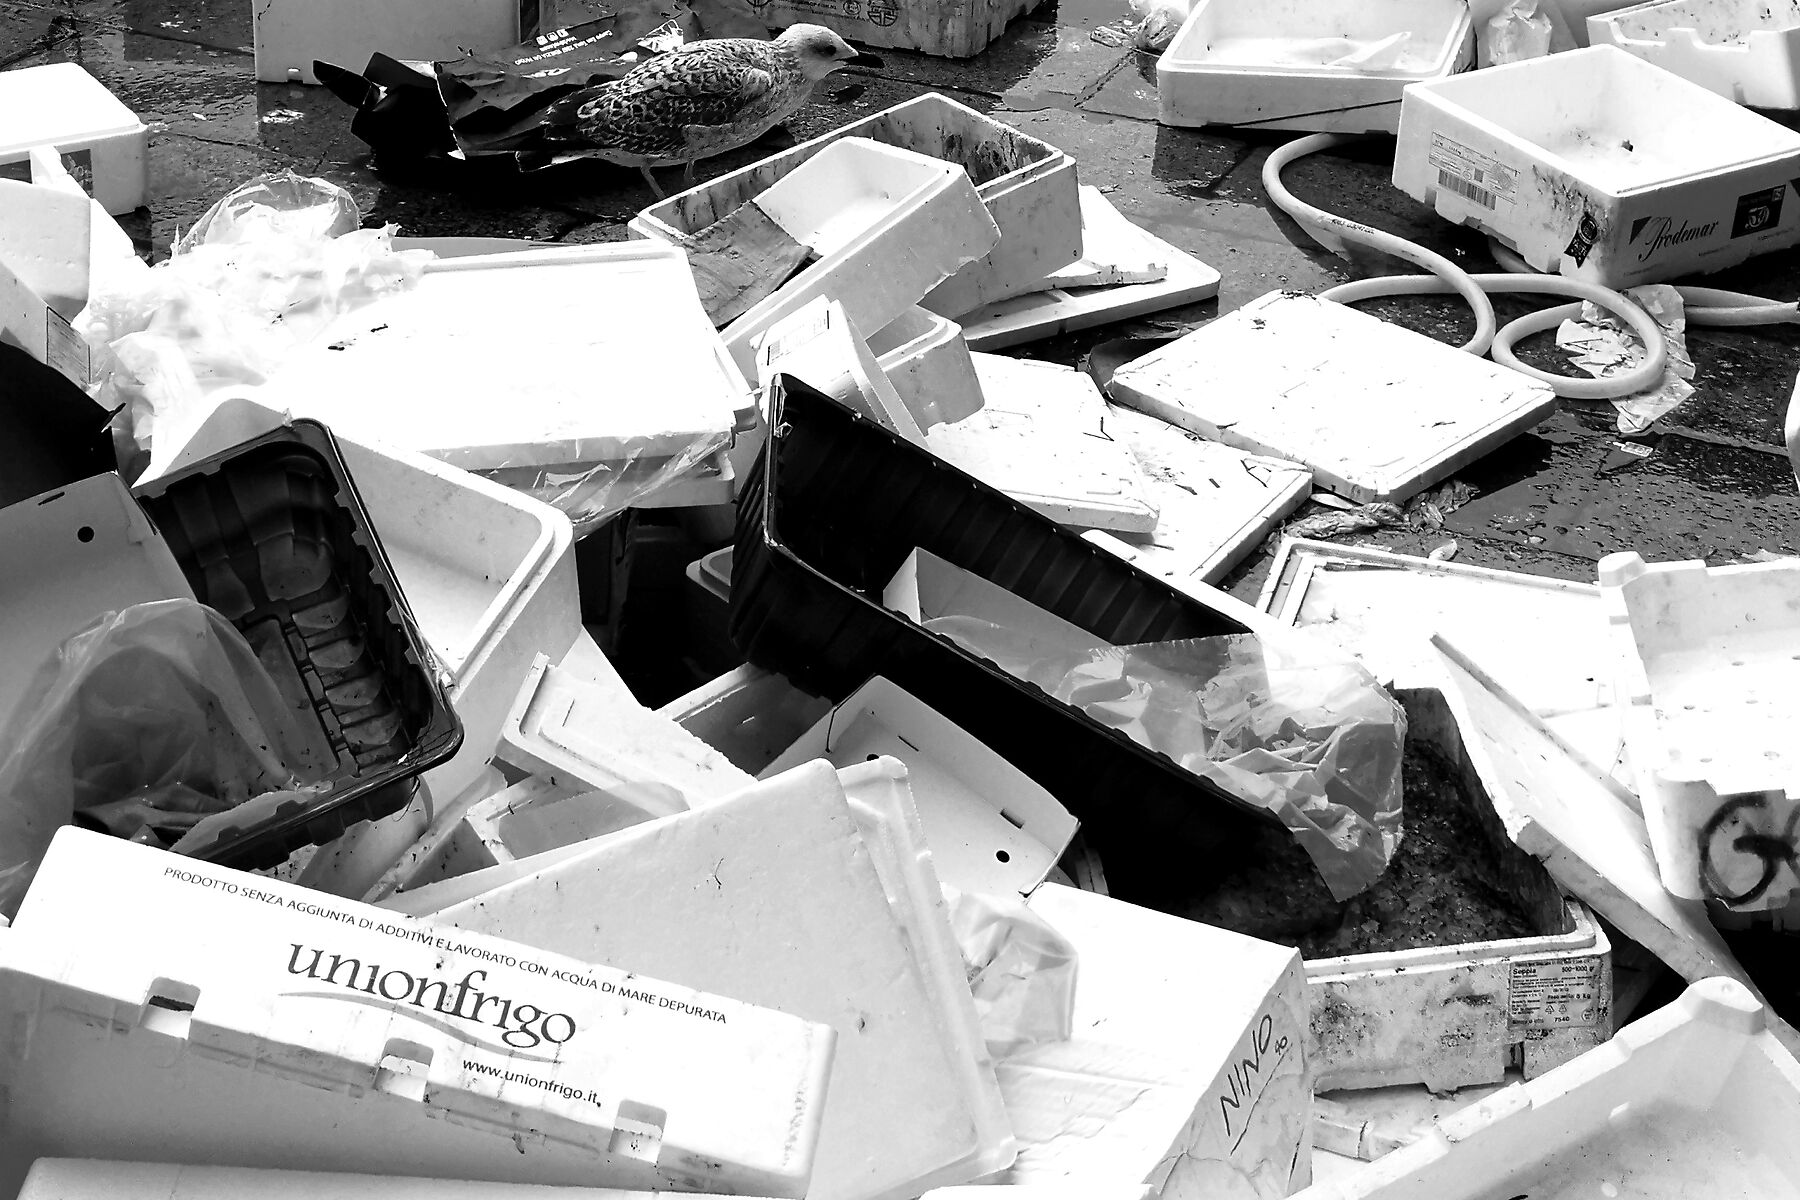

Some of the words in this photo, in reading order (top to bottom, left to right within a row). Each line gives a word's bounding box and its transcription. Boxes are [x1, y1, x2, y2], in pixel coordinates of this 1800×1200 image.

[1638, 216, 1720, 263] Prodemar
[164, 867, 238, 894] PRODOTTO
[240, 887, 284, 907] SENZA
[287, 900, 355, 926] AGGIUNTA
[358, 918, 373, 930] DI
[375, 923, 434, 946] ADDITIVI
[436, 938, 445, 949] E
[447, 941, 516, 967] LAVORATO
[519, 960, 549, 977] CON
[551, 970, 598, 989] ACQUA
[601, 982, 616, 994] DI
[618, 986, 656, 1005] MARE
[658, 997, 727, 1024] DEPURATA
[287, 943, 576, 1049] unionfrigo
[462, 1058, 599, 1104] www.unionfrigo.it
[1220, 1014, 1273, 1137] NINO
